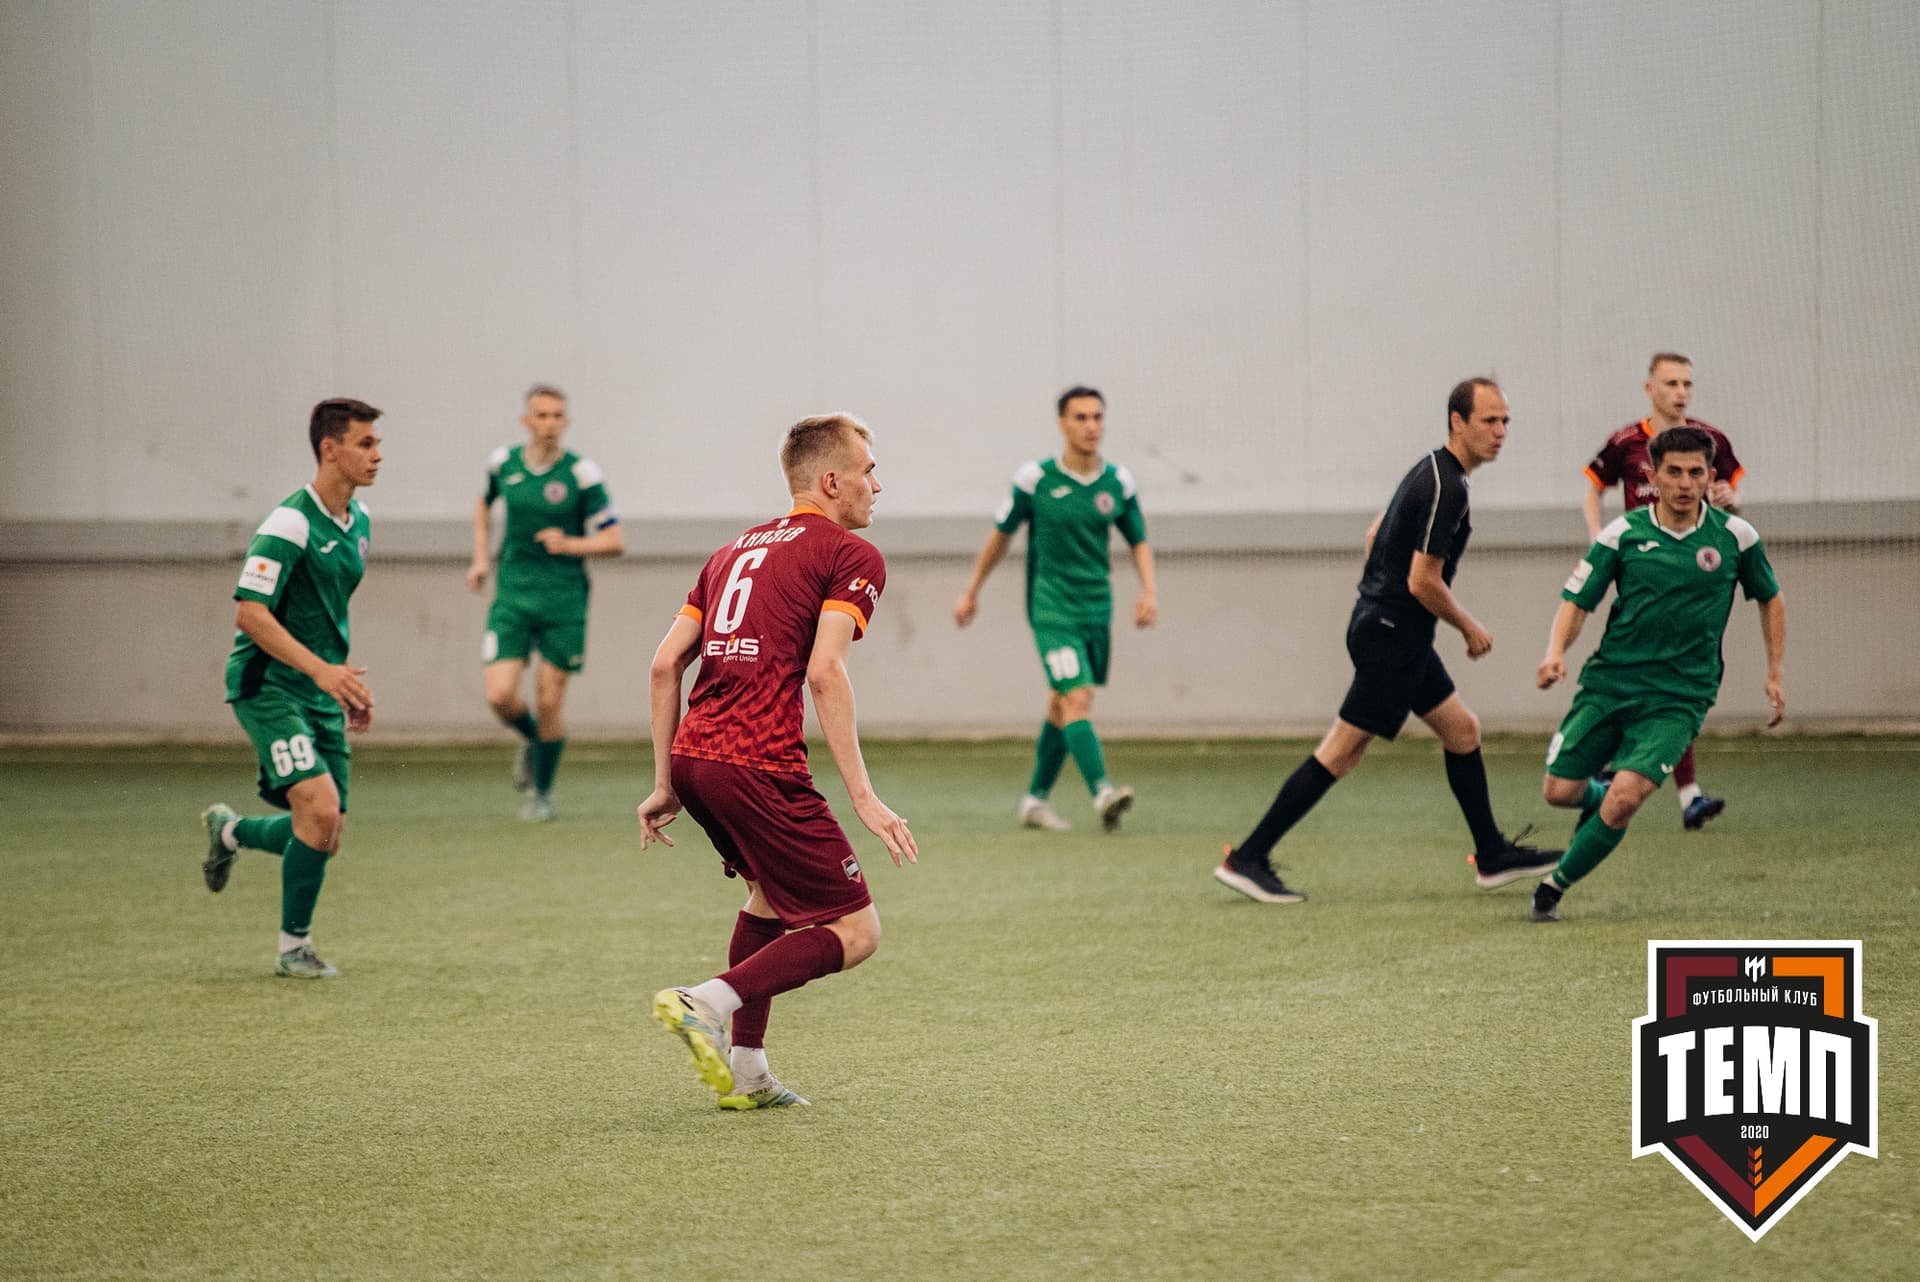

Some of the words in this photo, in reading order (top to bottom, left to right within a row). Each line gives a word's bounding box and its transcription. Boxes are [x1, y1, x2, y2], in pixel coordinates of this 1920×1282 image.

[714, 547, 768, 634] 6
[703, 637, 760, 657] EUS
[270, 734, 316, 778] 69
